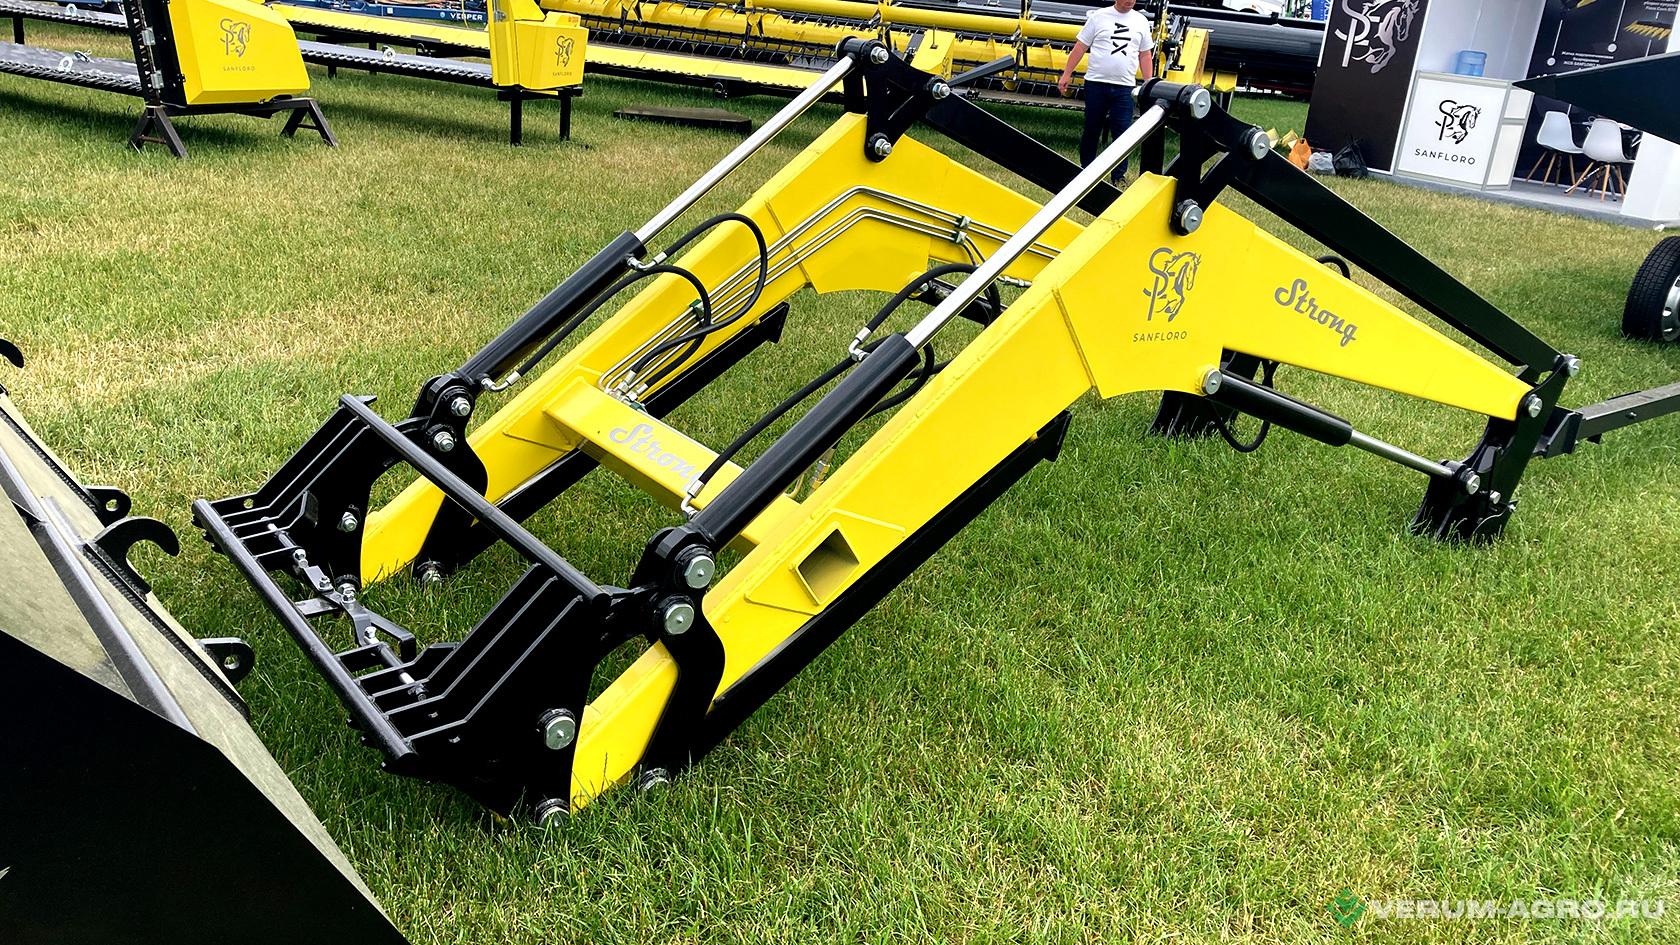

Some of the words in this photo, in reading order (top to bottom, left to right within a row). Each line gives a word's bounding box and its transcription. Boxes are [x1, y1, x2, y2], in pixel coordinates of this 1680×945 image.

[1414, 148, 1476, 165] SANFLORO
[1274, 278, 1359, 347] Strong
[1132, 330, 1188, 343] SANFLORO
